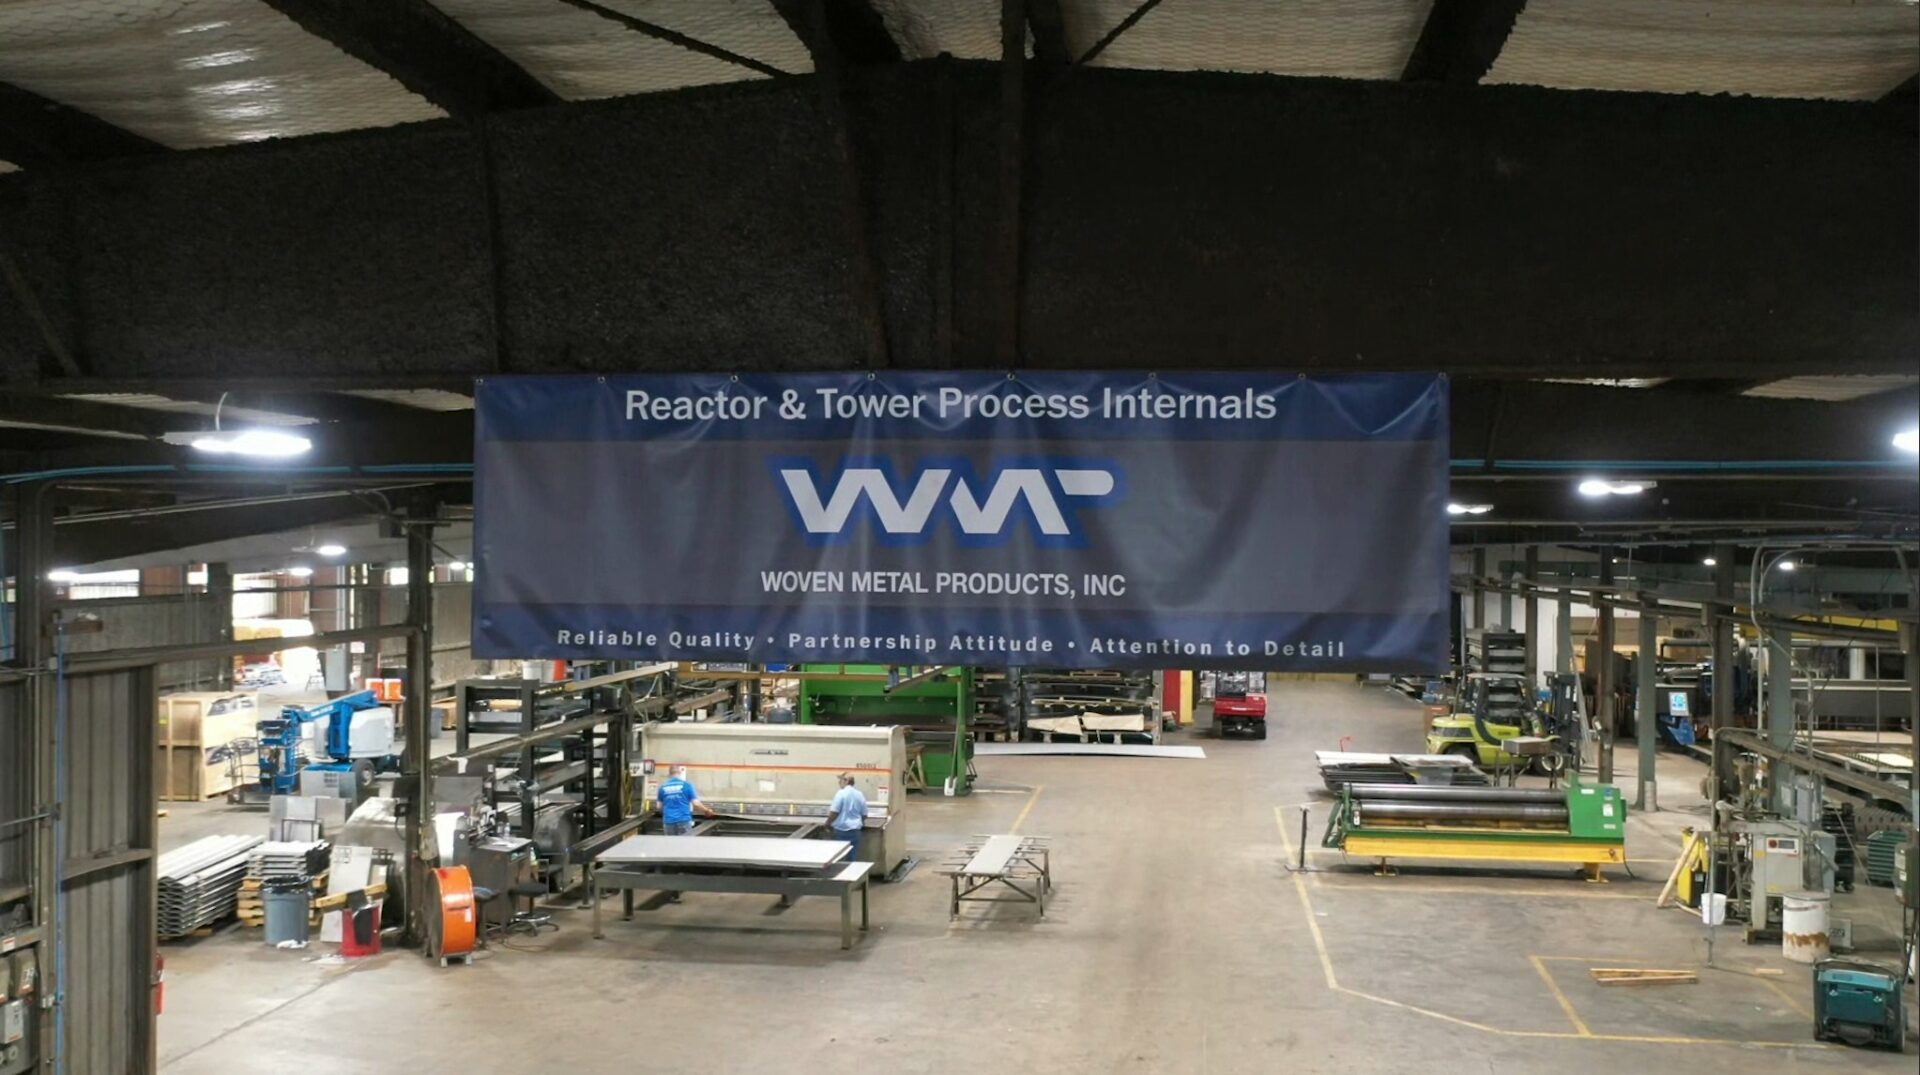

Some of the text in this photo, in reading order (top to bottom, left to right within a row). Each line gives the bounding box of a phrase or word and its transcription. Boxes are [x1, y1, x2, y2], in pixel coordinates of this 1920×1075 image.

[626, 387, 1277, 420] Reactor & Tower Process Internals
[781, 469, 1114, 534] WMP
[761, 571, 1126, 599] WOVEN METAL PRODUCTS, INC
[557, 630, 1345, 658] Reliable Quality Partnership Attitude Attention to Detail
